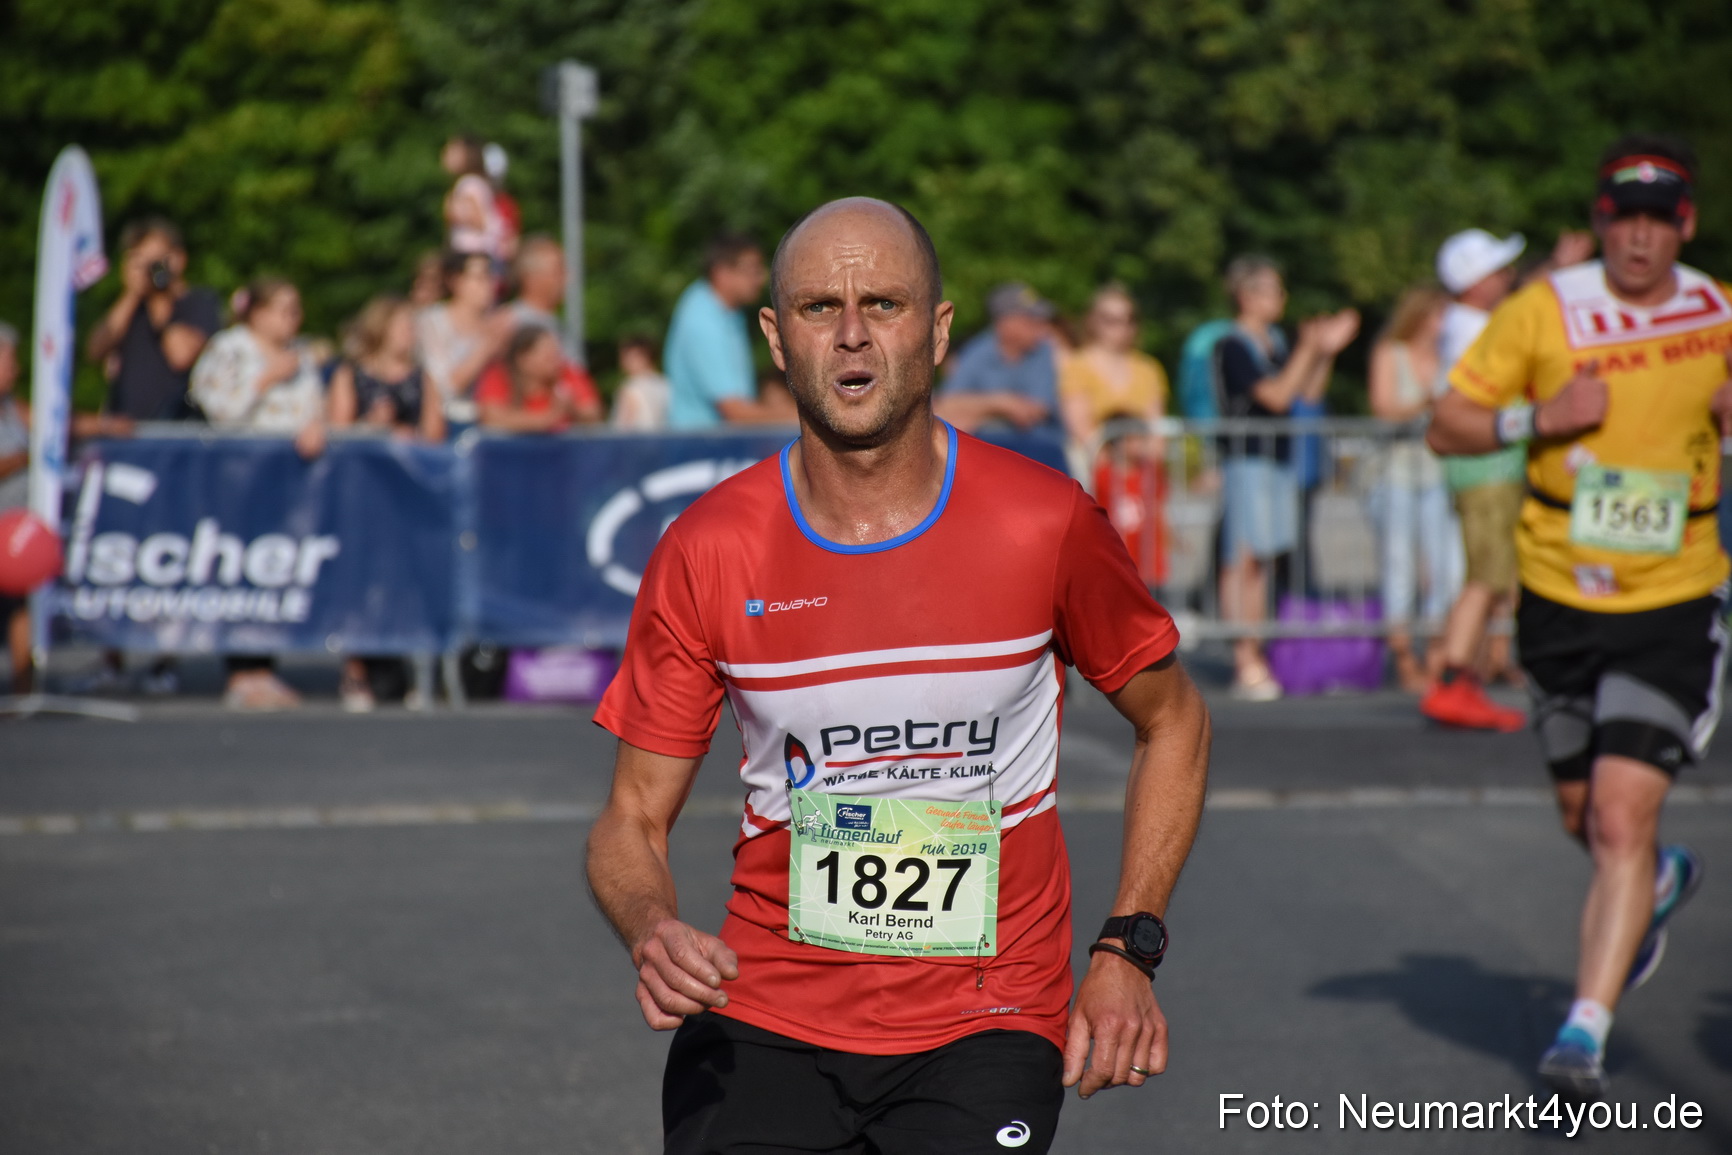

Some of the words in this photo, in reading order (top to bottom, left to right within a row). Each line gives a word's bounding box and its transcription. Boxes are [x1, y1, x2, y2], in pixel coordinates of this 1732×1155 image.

[1590, 498, 1671, 533] 1563
[820, 716, 1000, 757] Petry
[887, 766, 942, 780] KÄLTE
[950, 764, 997, 779] KLIMA
[820, 838, 855, 847] neumarkt
[821, 823, 904, 844] firmenlauf
[920, 844, 946, 856] run
[951, 843, 987, 855] 2019
[816, 850, 972, 912] 1827
[848, 910, 880, 926] Karl
[885, 914, 934, 929] Bernd
[865, 929, 894, 942] Petry
[896, 931, 914, 941] AG
